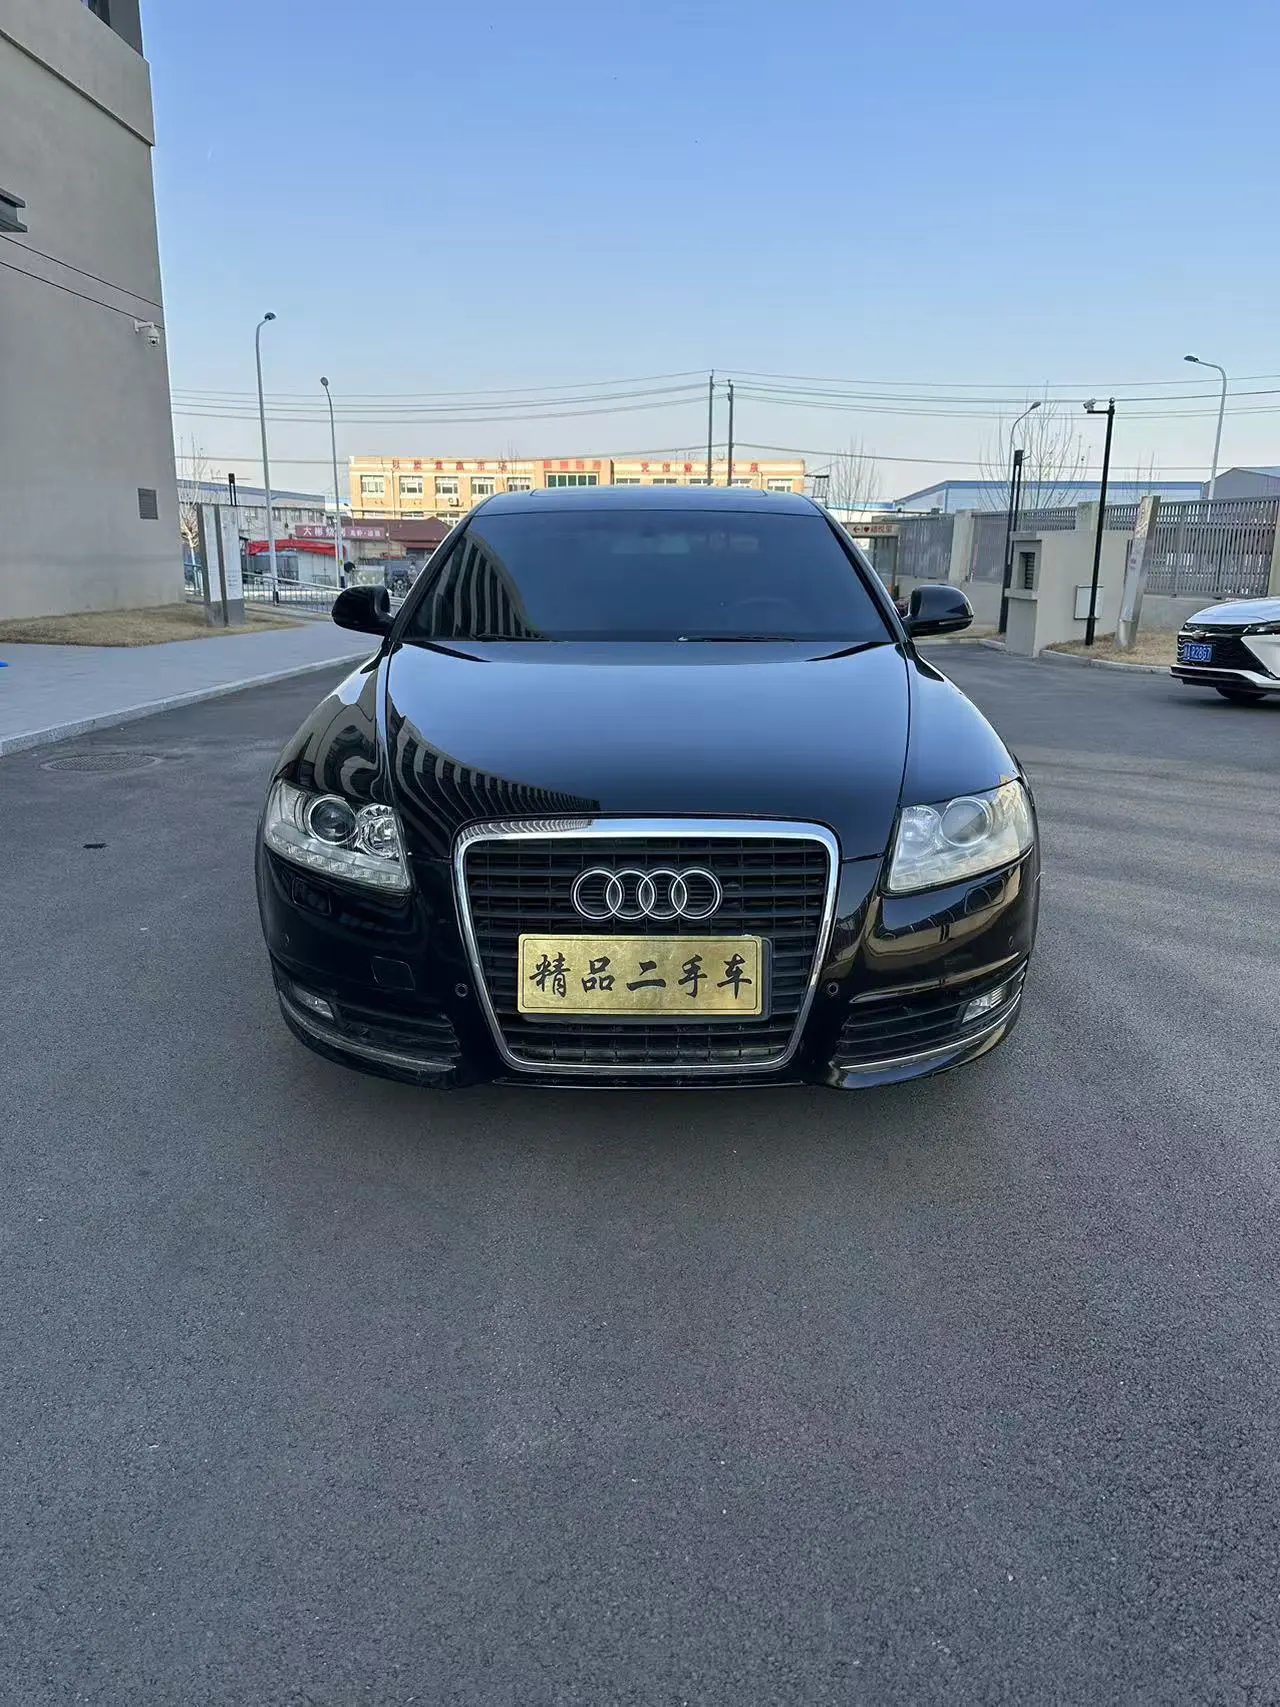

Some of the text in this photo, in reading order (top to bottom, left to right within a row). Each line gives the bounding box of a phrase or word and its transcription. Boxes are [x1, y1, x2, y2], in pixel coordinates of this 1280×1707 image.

[529, 951, 753, 999] 精品二手车
